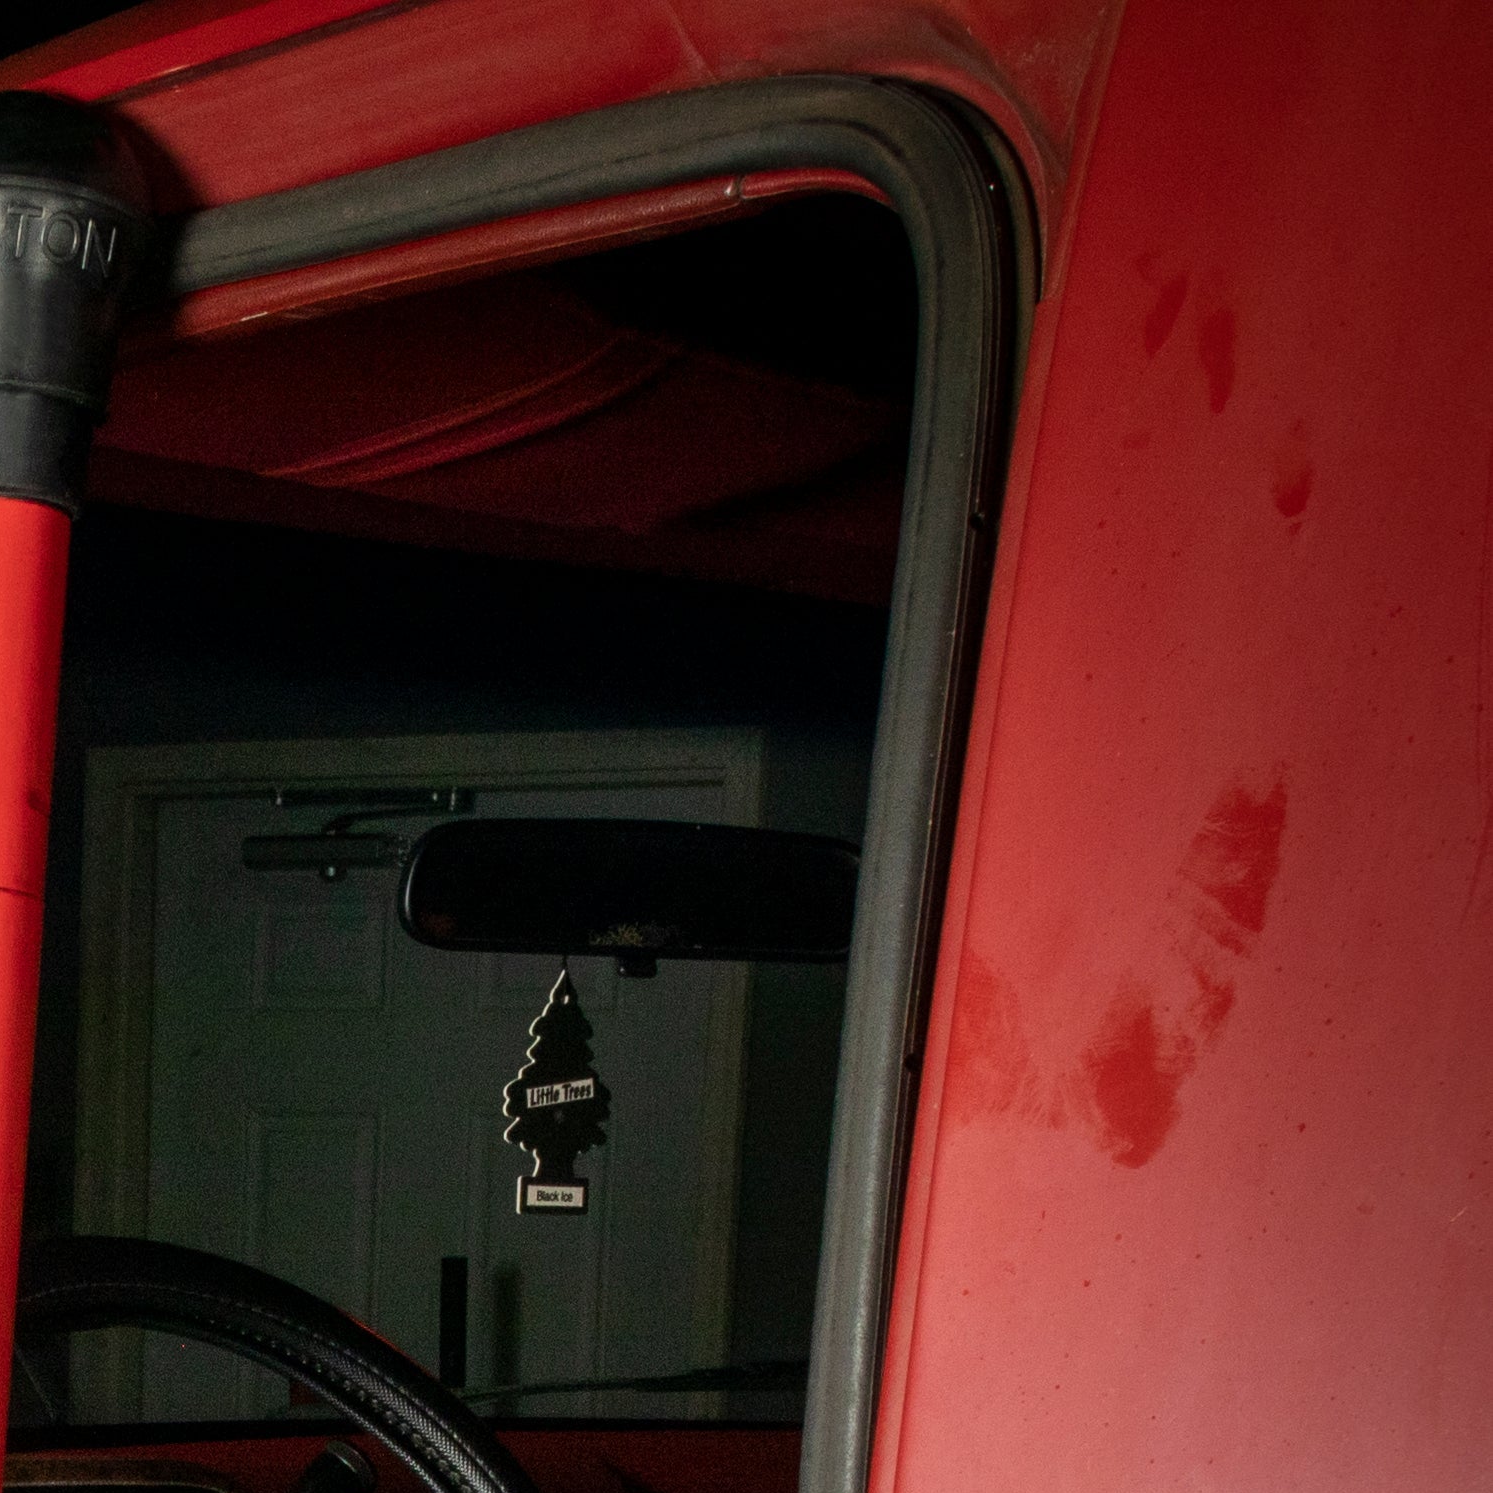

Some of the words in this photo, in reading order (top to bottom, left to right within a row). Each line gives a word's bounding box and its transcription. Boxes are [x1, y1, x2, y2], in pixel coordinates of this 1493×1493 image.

[530, 1085, 560, 1106] Little
[562, 1082, 591, 1100] Trees
[536, 1190, 559, 1202] Black
[561, 1190, 573, 1202] Ice
